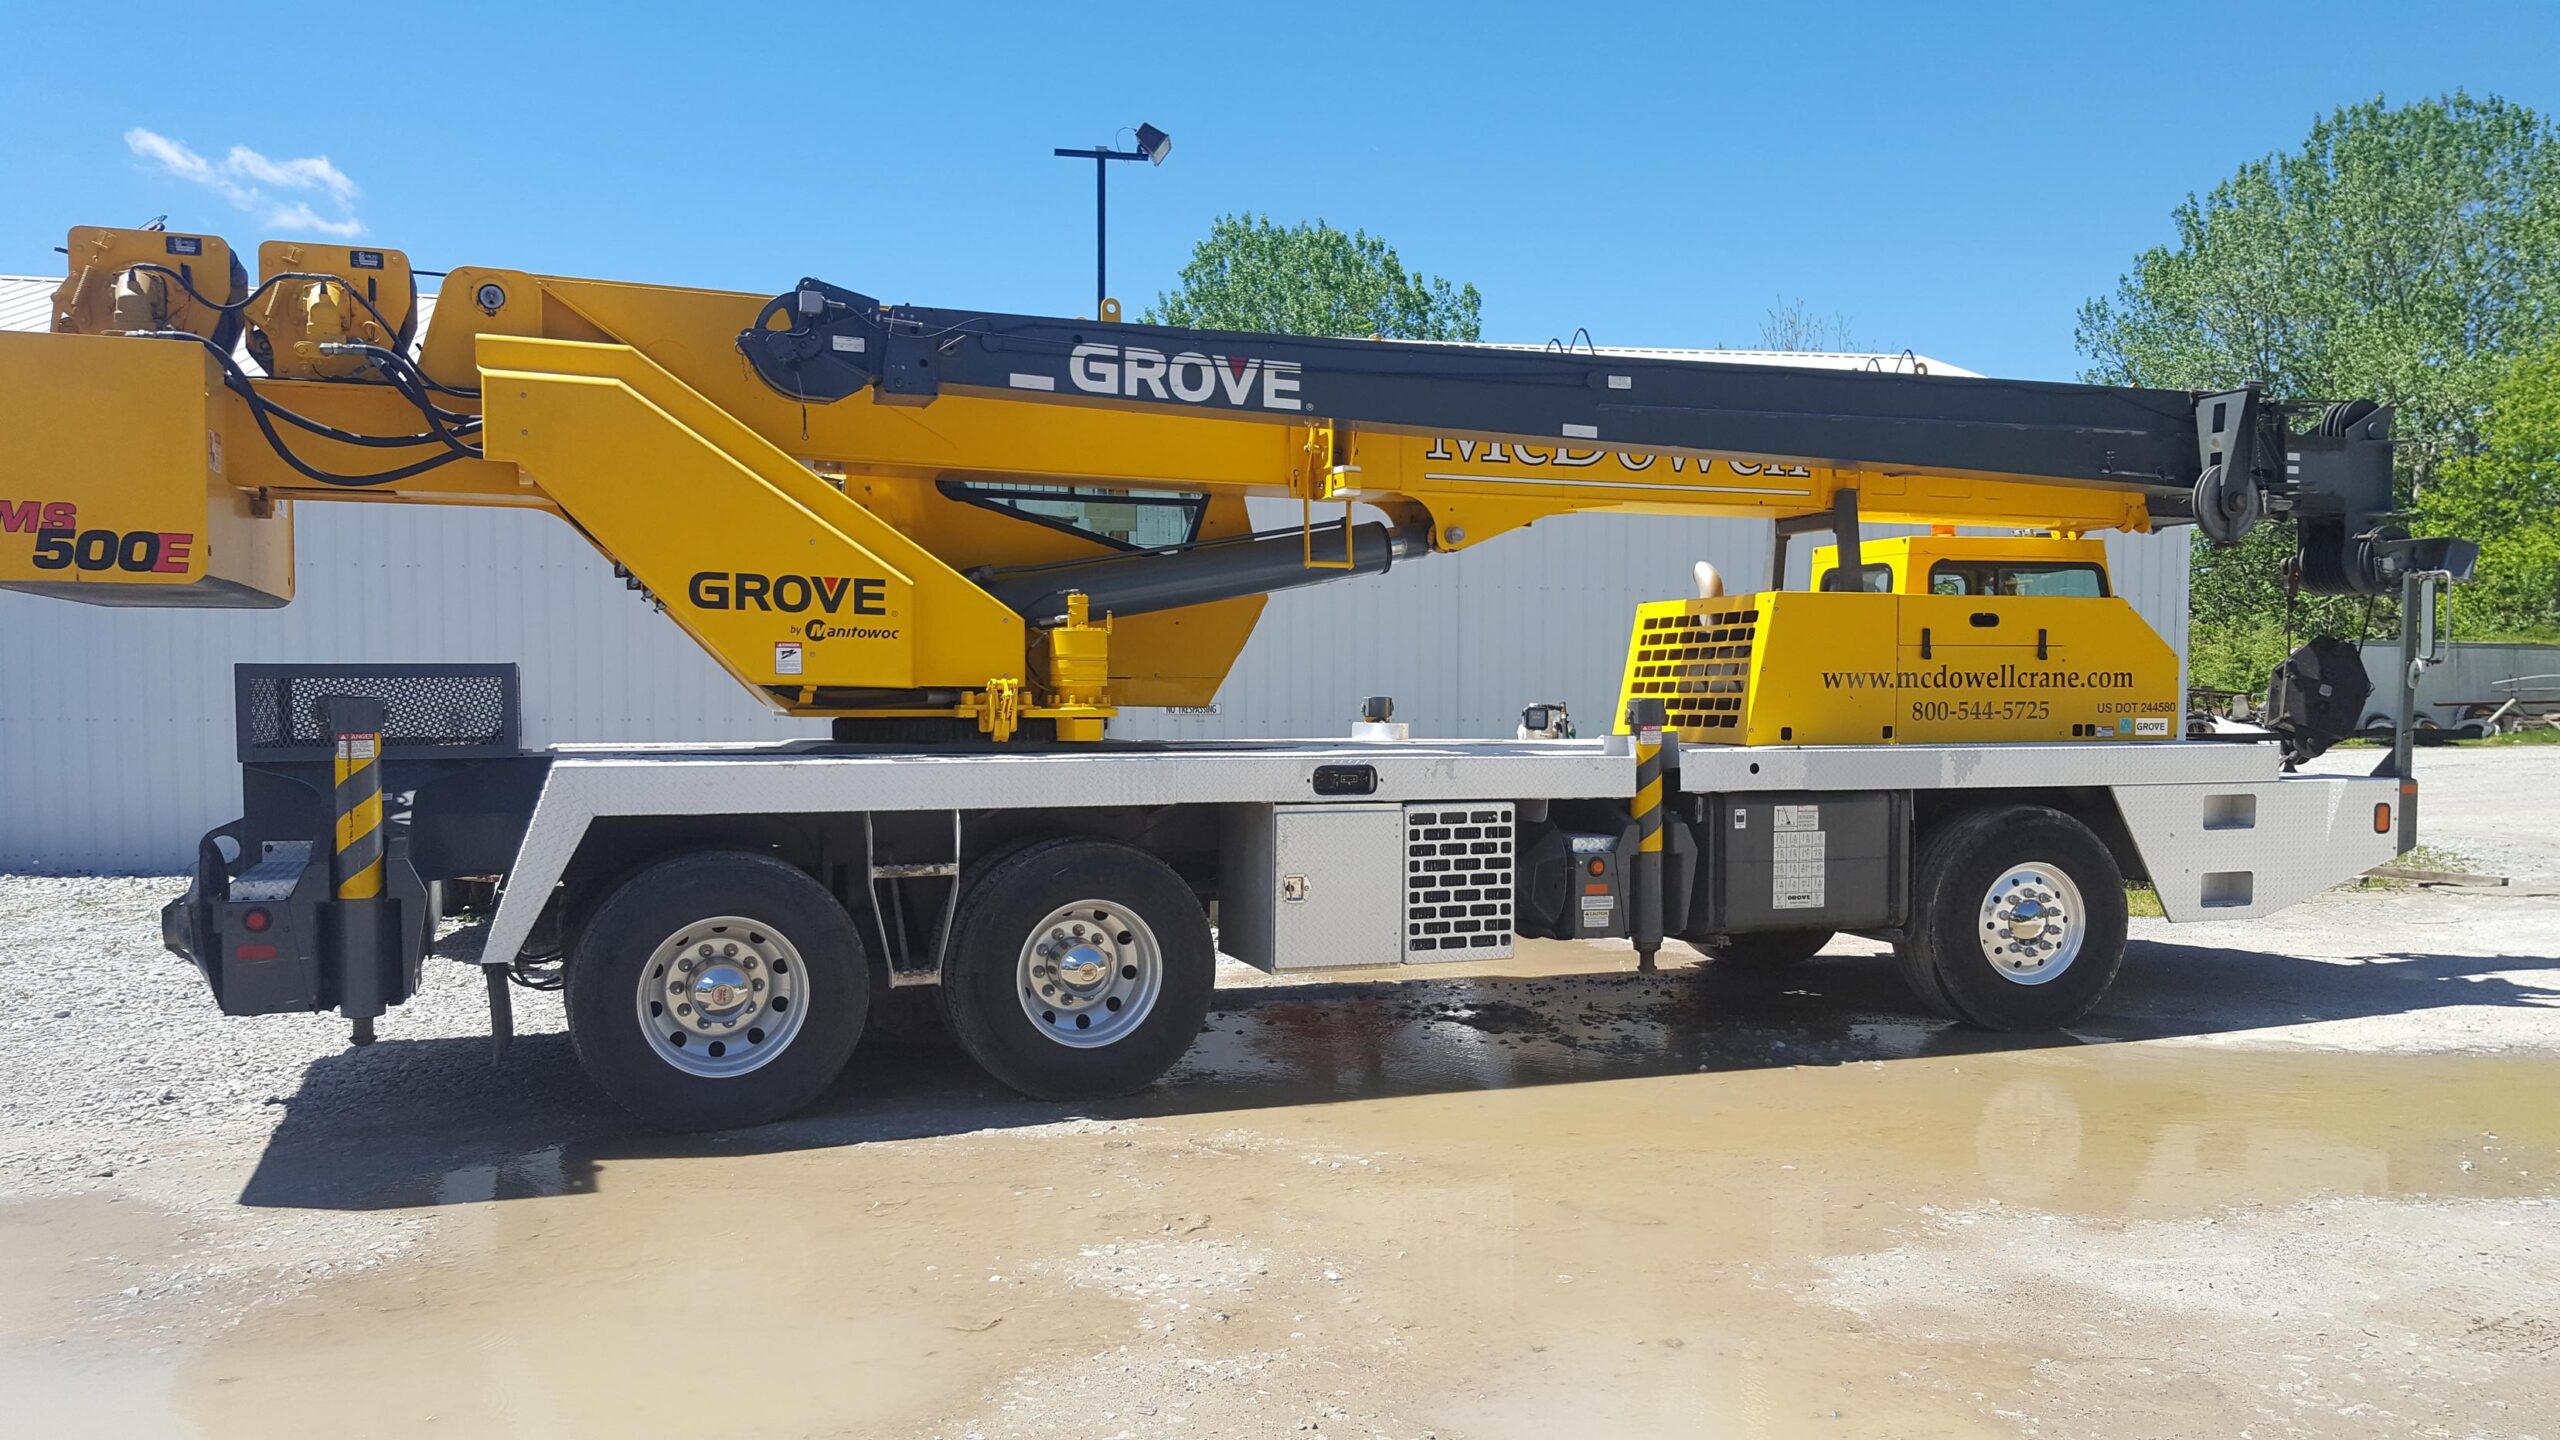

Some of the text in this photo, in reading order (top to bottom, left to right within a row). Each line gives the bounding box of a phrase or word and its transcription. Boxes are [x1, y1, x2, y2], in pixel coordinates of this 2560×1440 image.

[1070, 343, 1302, 410] GROVE
[32, 528, 194, 574] 500E
[689, 572, 886, 615] GROVE
[790, 619, 900, 641] by Manitowoc
[1822, 664, 2134, 689] www.mcdowellcrane.com
[1166, 705, 1217, 714] NO TRESPASSING
[1911, 701, 2050, 721] 800-544-5725
[2097, 702, 2176, 714] US DOT 244580
[2136, 722, 2166, 732] GROVE
